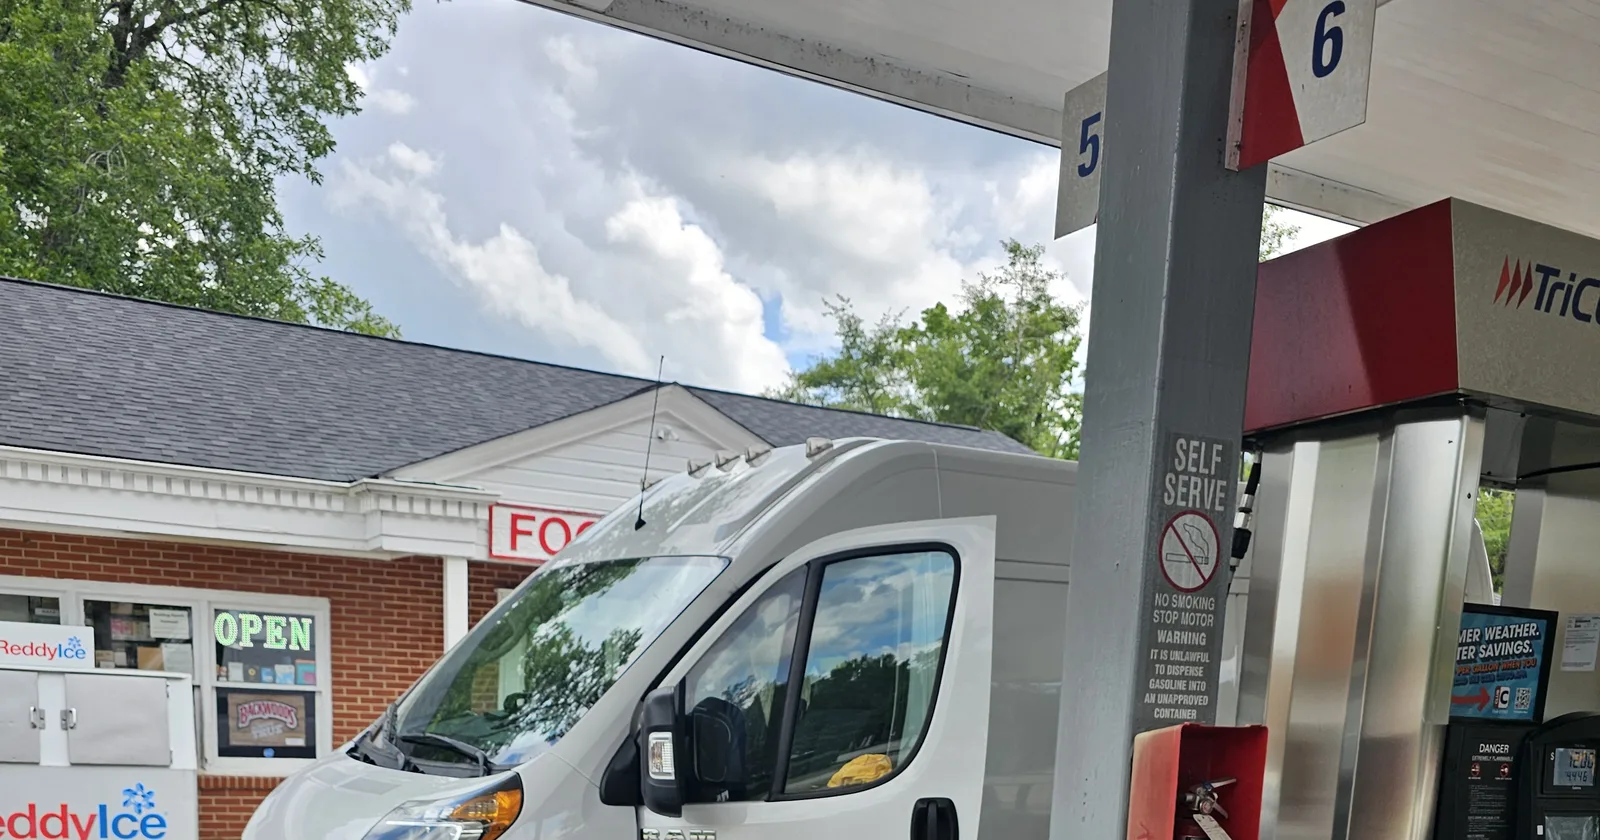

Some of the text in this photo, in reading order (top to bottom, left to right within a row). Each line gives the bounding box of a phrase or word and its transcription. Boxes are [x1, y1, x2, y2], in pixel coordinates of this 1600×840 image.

[1311, 0, 1346, 78] 6
[1077, 112, 1101, 178] 5
[1534, 263, 1600, 326] TriC
[1174, 437, 1223, 476] SELF
[1163, 472, 1227, 512] SERVE
[511, 512, 597, 556] FO
[1154, 593, 1215, 610] NO SMOKING
[1153, 609, 1214, 627] STOP MOTOR
[213, 612, 312, 651] OPEN
[1157, 629, 1207, 646] WARNING
[1484, 622, 1540, 641] WEATHER.
[1150, 648, 1210, 663] IT IS UNLAWFUL
[1478, 640, 1533, 658] SAVINGS.
[1155, 664, 1204, 677] TO DISPENSE
[1473, 663, 1499, 673] GALLON
[1501, 660, 1521, 670] WHEN
[1522, 658, 1537, 668] YOU
[1149, 679, 1207, 692] GASOLINE INTO
[1144, 693, 1209, 706] AN UNAPPROVED
[1154, 708, 1197, 720] CONTAINER
[1479, 743, 1510, 754] DANGER
[0, 803, 167, 840] ddyIce
